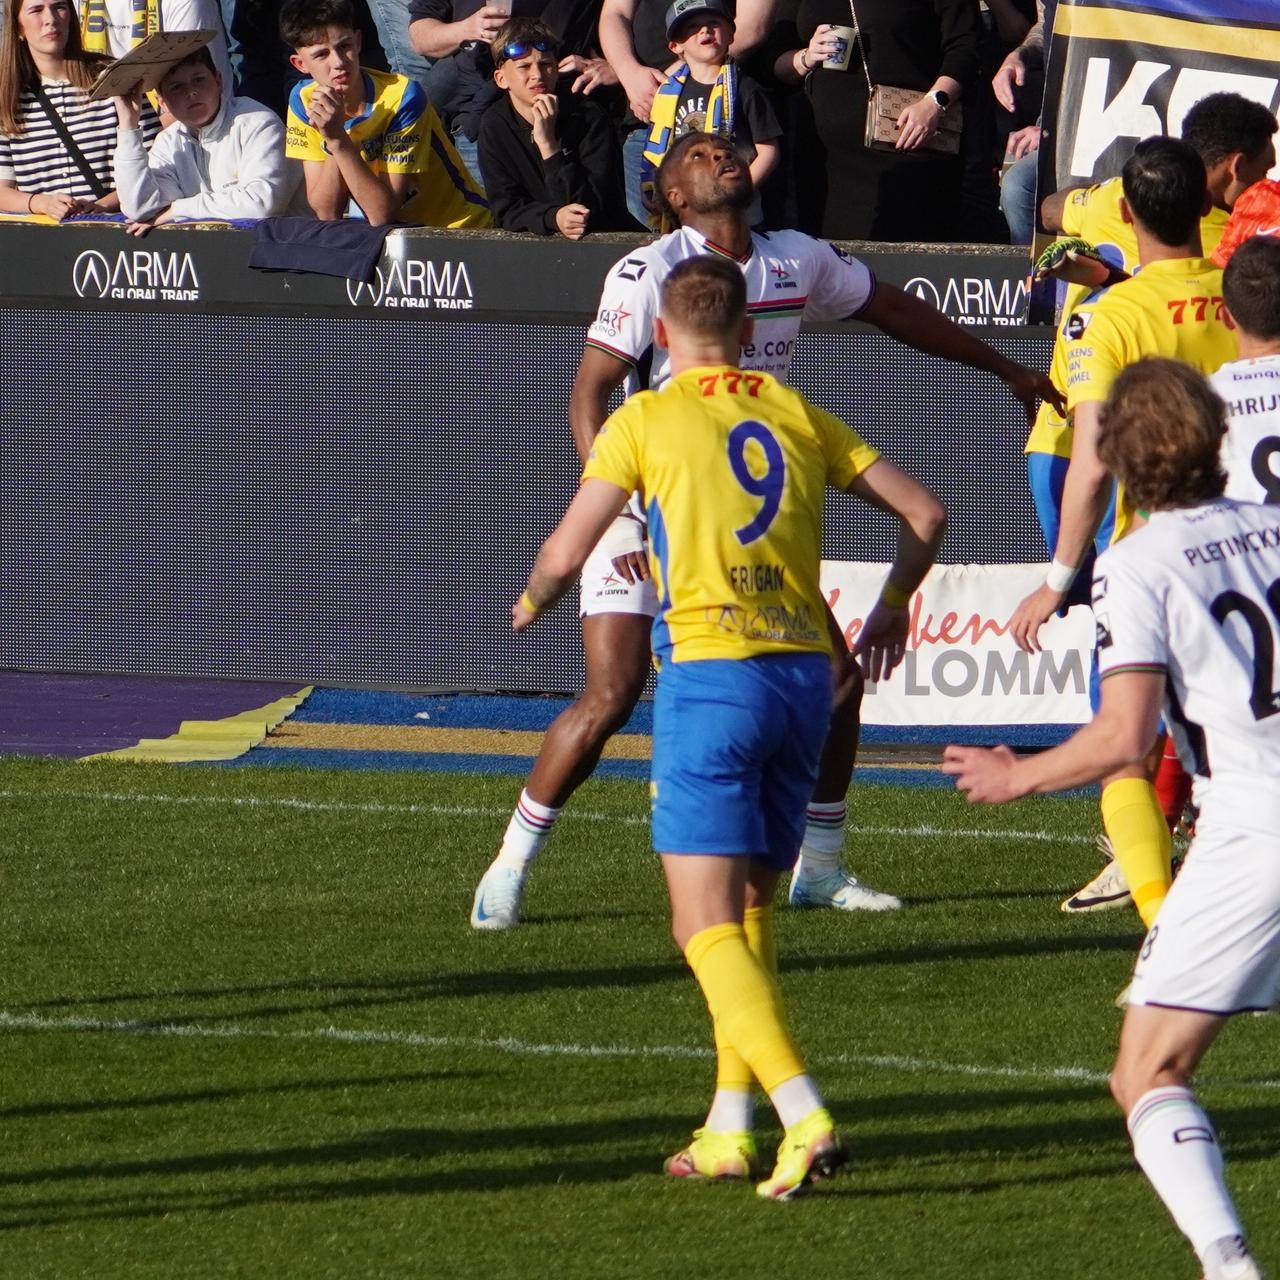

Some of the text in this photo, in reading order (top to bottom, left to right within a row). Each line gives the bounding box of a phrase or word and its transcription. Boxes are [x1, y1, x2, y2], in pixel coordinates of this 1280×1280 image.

[111, 251, 200, 288] ARMA
[385, 261, 473, 297] ARMA
[941, 278, 1027, 316] ARMA
[957, 316, 1000, 327] LOBAL
[698, 371, 764, 398] 777
[727, 419, 787, 547] 9
[905, 649, 1088, 699] LOMM
